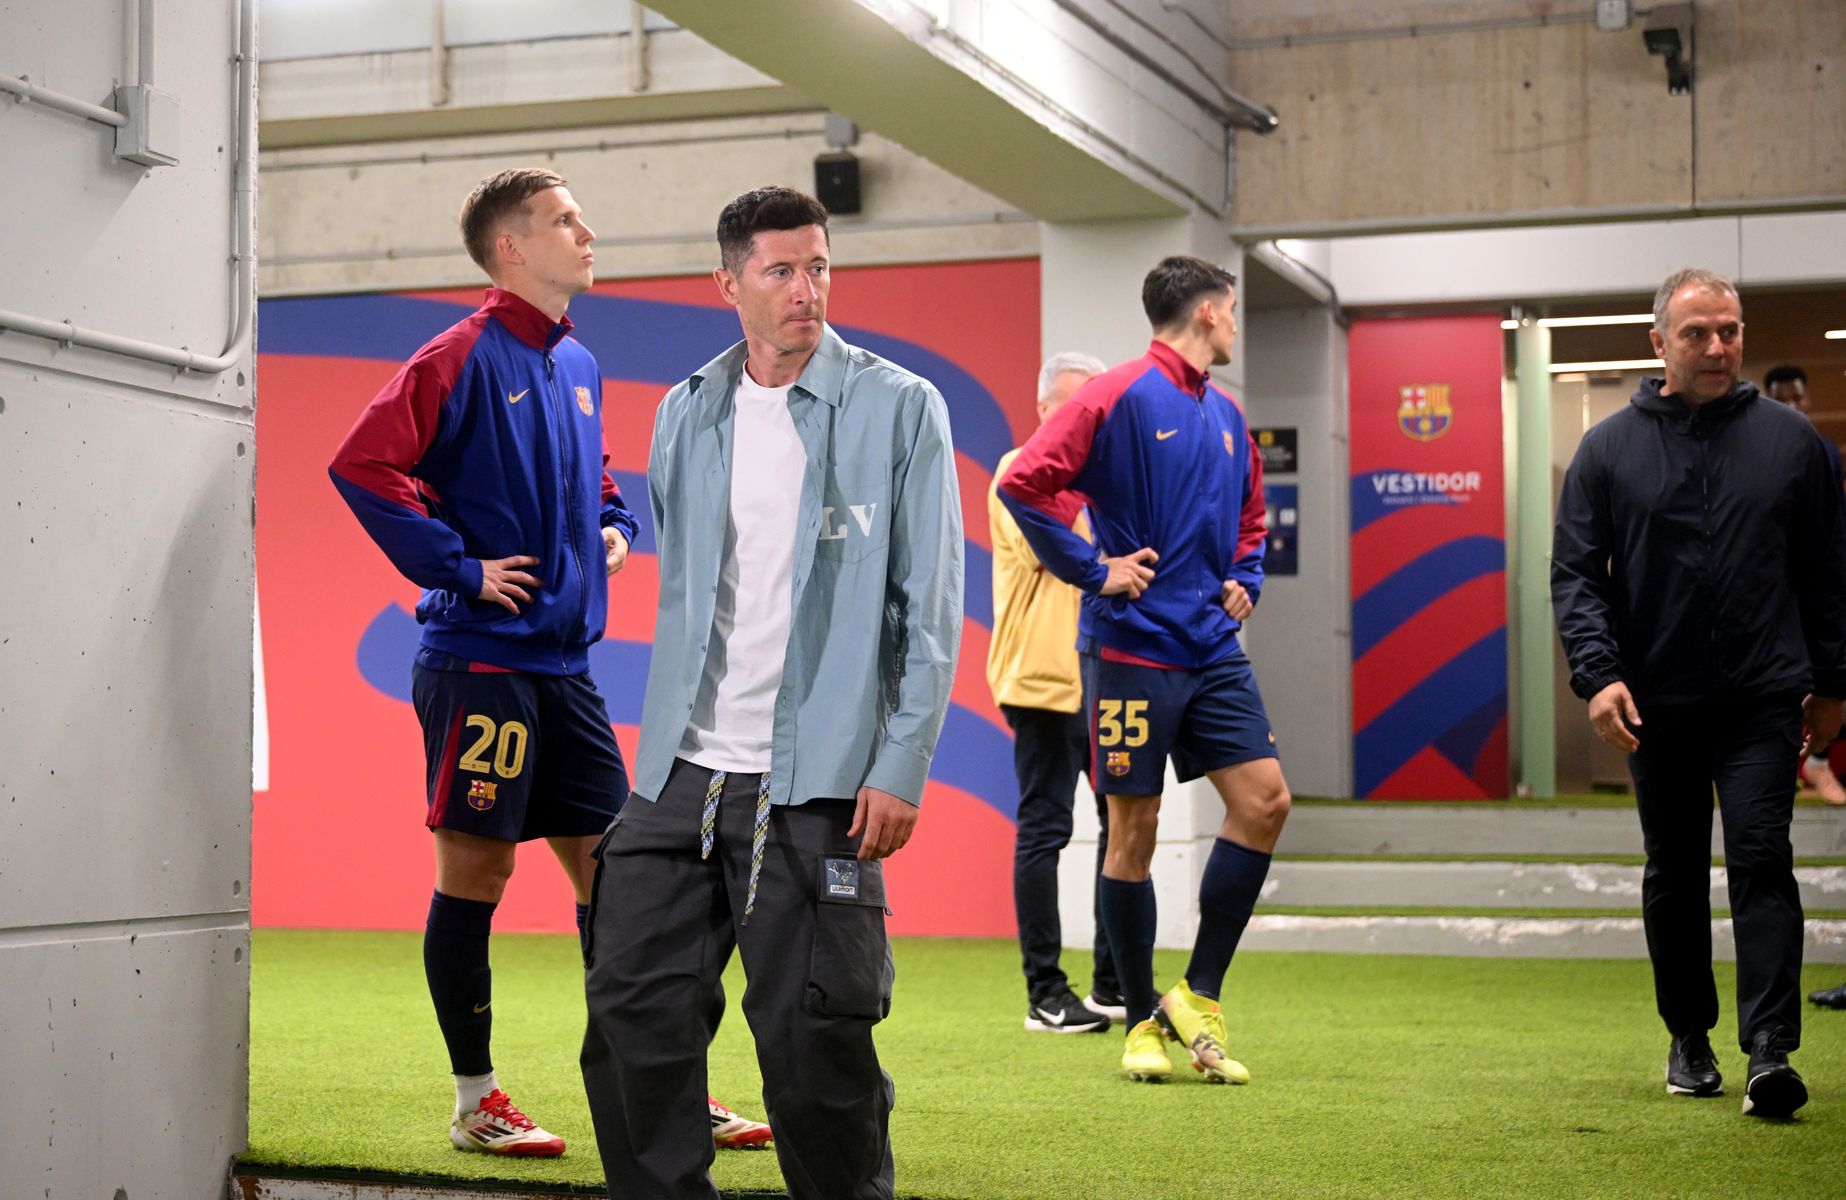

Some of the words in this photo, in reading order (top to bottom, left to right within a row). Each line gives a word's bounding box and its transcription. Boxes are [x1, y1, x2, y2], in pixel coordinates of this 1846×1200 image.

[1372, 471, 1481, 494] VESTIDOR
[819, 503, 877, 540] LV
[1099, 699, 1149, 747] 35
[459, 714, 528, 778] 20
